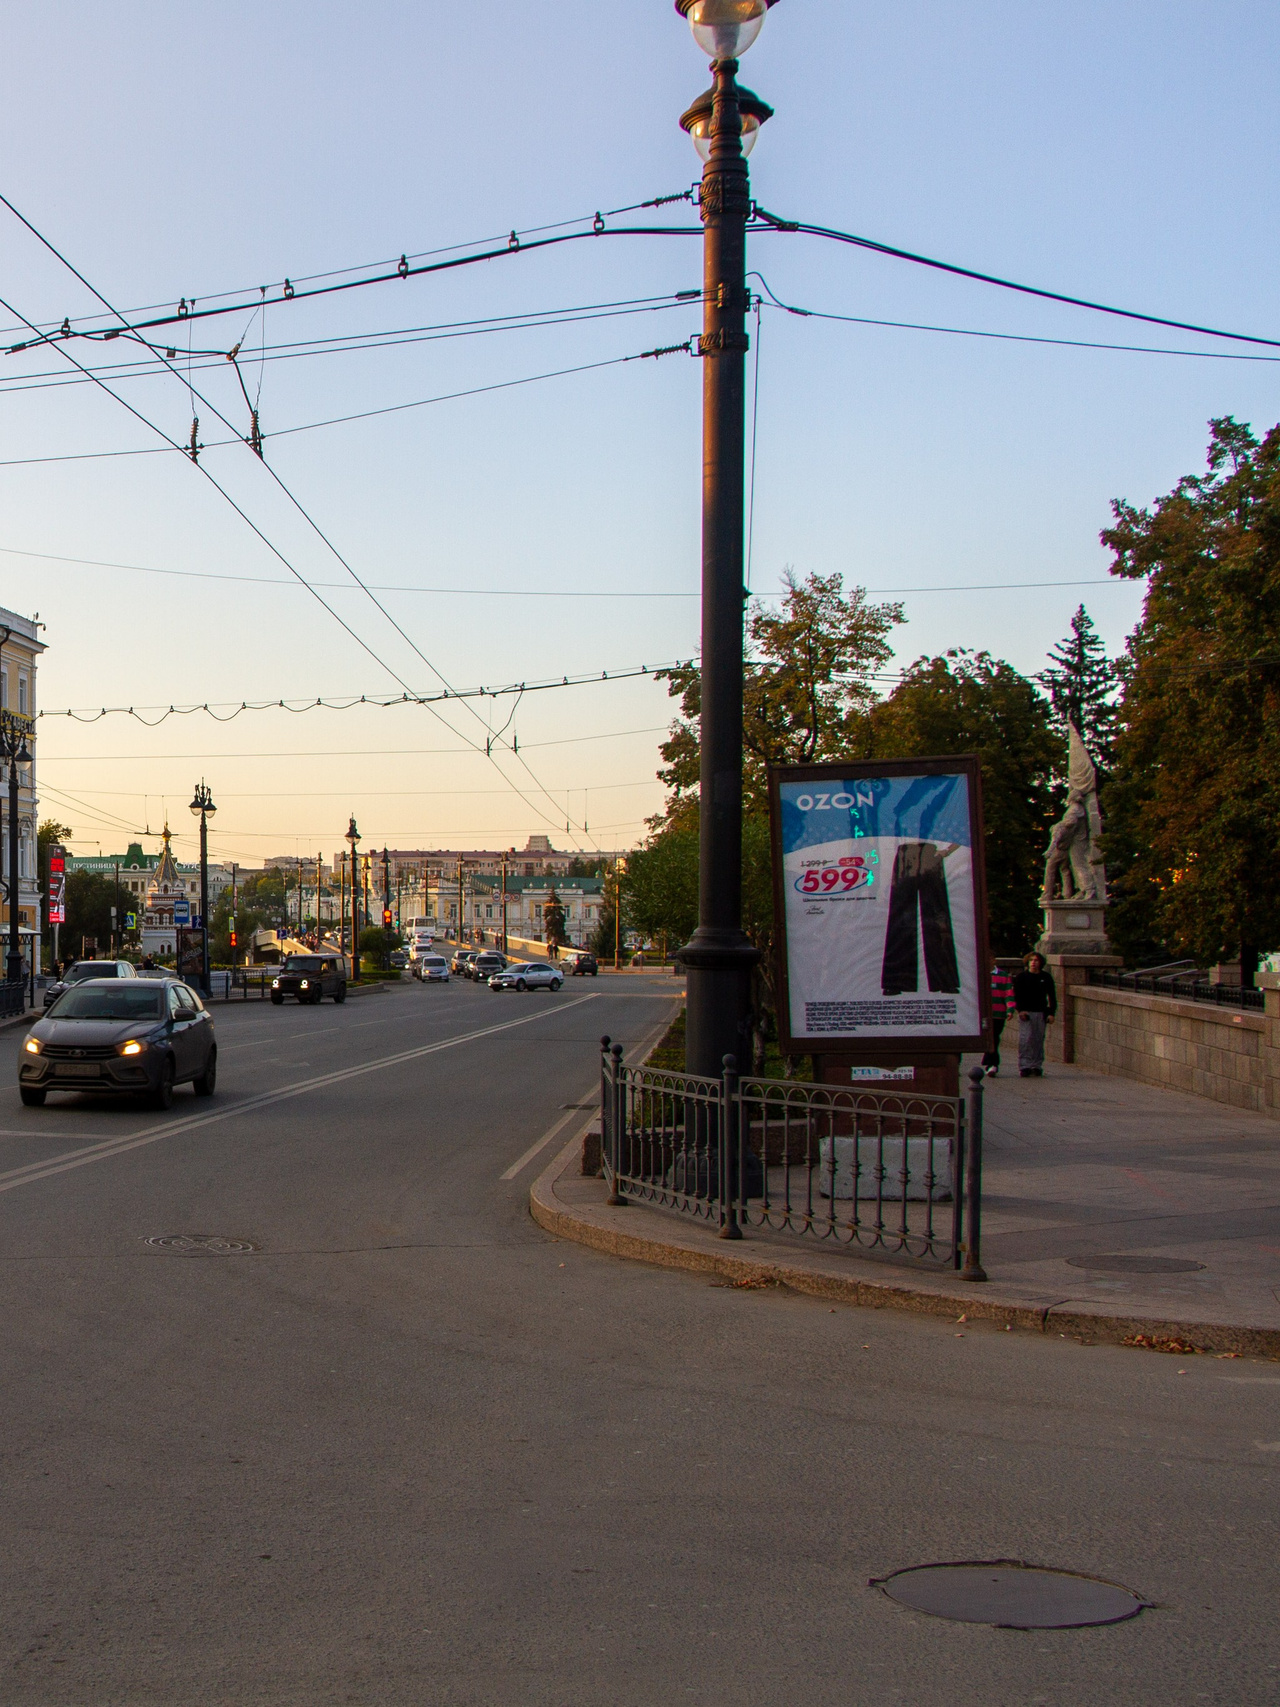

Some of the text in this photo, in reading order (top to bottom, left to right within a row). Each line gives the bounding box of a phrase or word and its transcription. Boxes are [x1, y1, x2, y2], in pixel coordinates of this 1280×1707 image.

[796, 791, 874, 811] OZON
[72, 862, 117, 870] ГОСТИНИЦА
[153, 861, 198, 870] РСИЯ
[802, 868, 859, 892] 599
